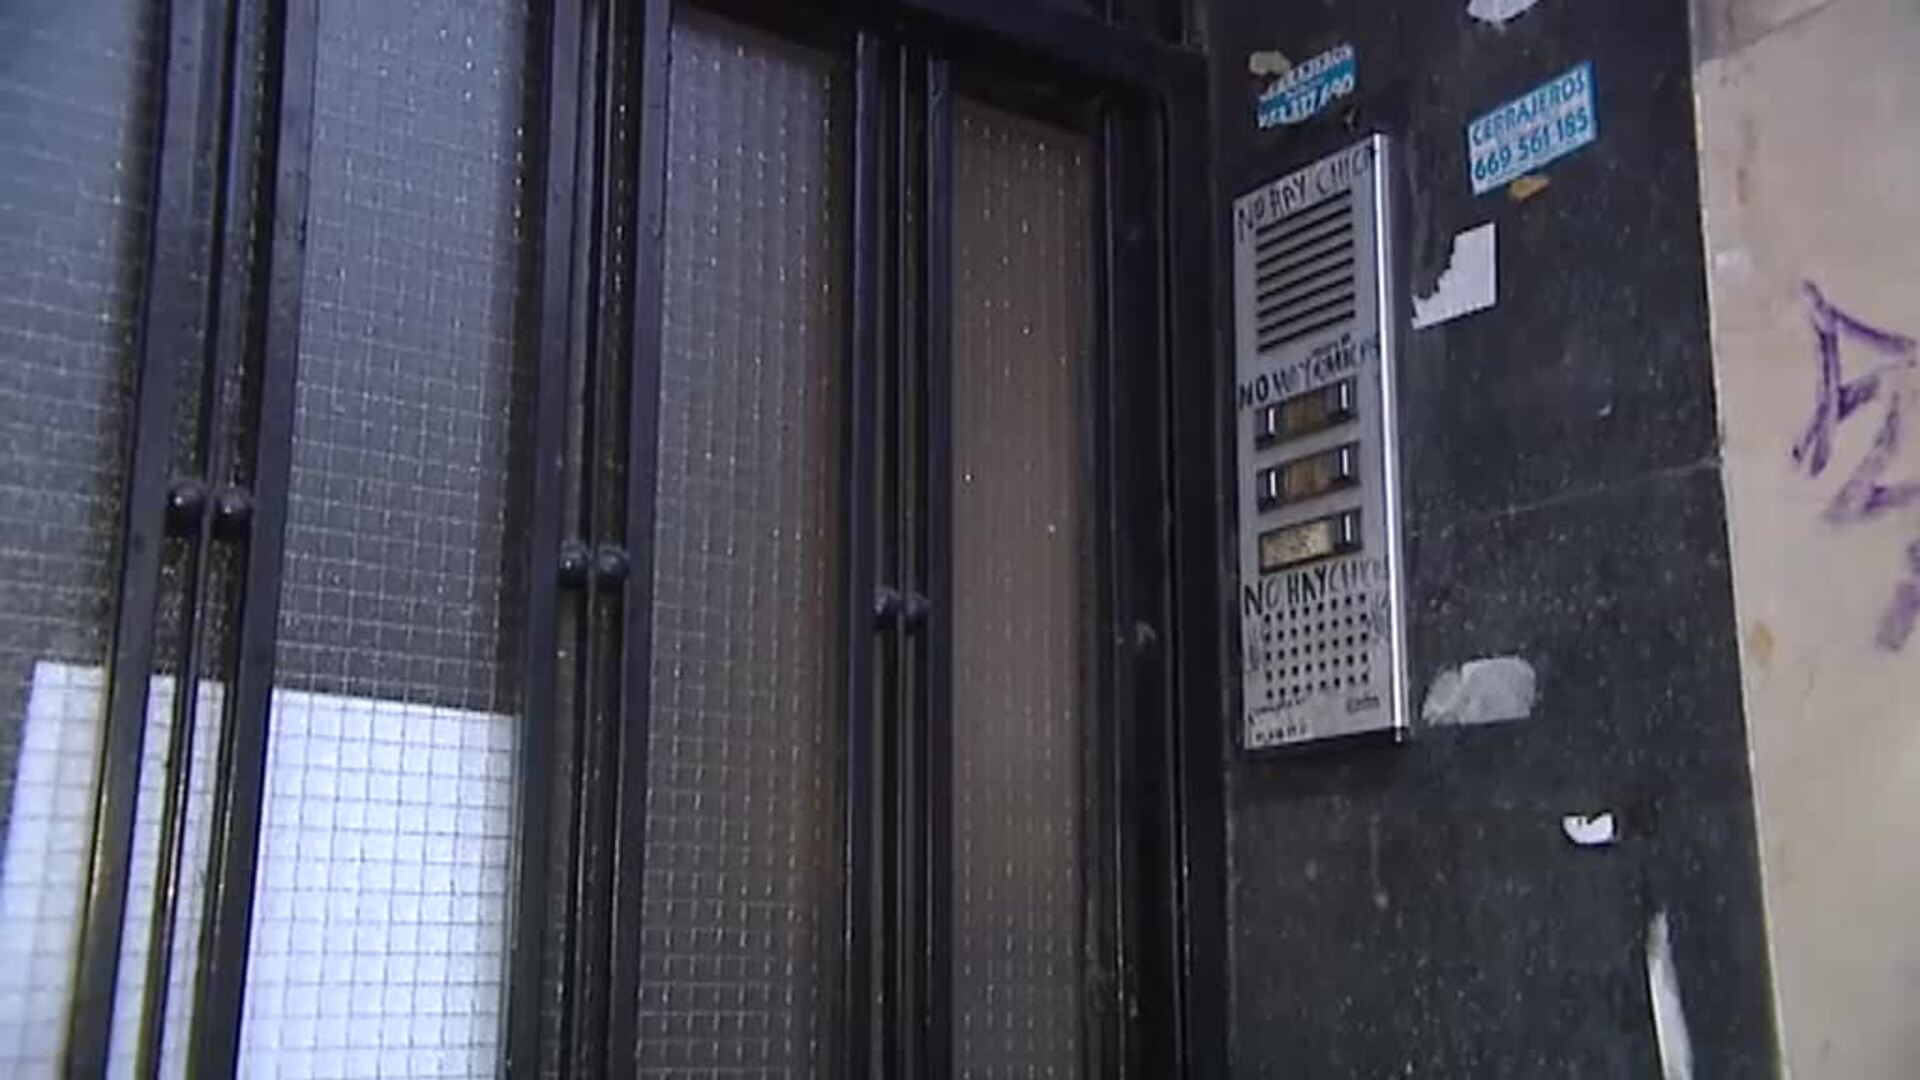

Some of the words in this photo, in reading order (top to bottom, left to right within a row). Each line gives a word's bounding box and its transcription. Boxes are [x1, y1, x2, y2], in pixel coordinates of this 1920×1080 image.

[1472, 72, 1585, 146] CERRAJEROS
[1475, 146, 1512, 181] 669
[1518, 127, 1550, 161] 561
[1557, 108, 1588, 143] 185
[1238, 374, 1270, 410] NO
[1244, 579, 1281, 616] NO
[1287, 564, 1327, 605] HAY
